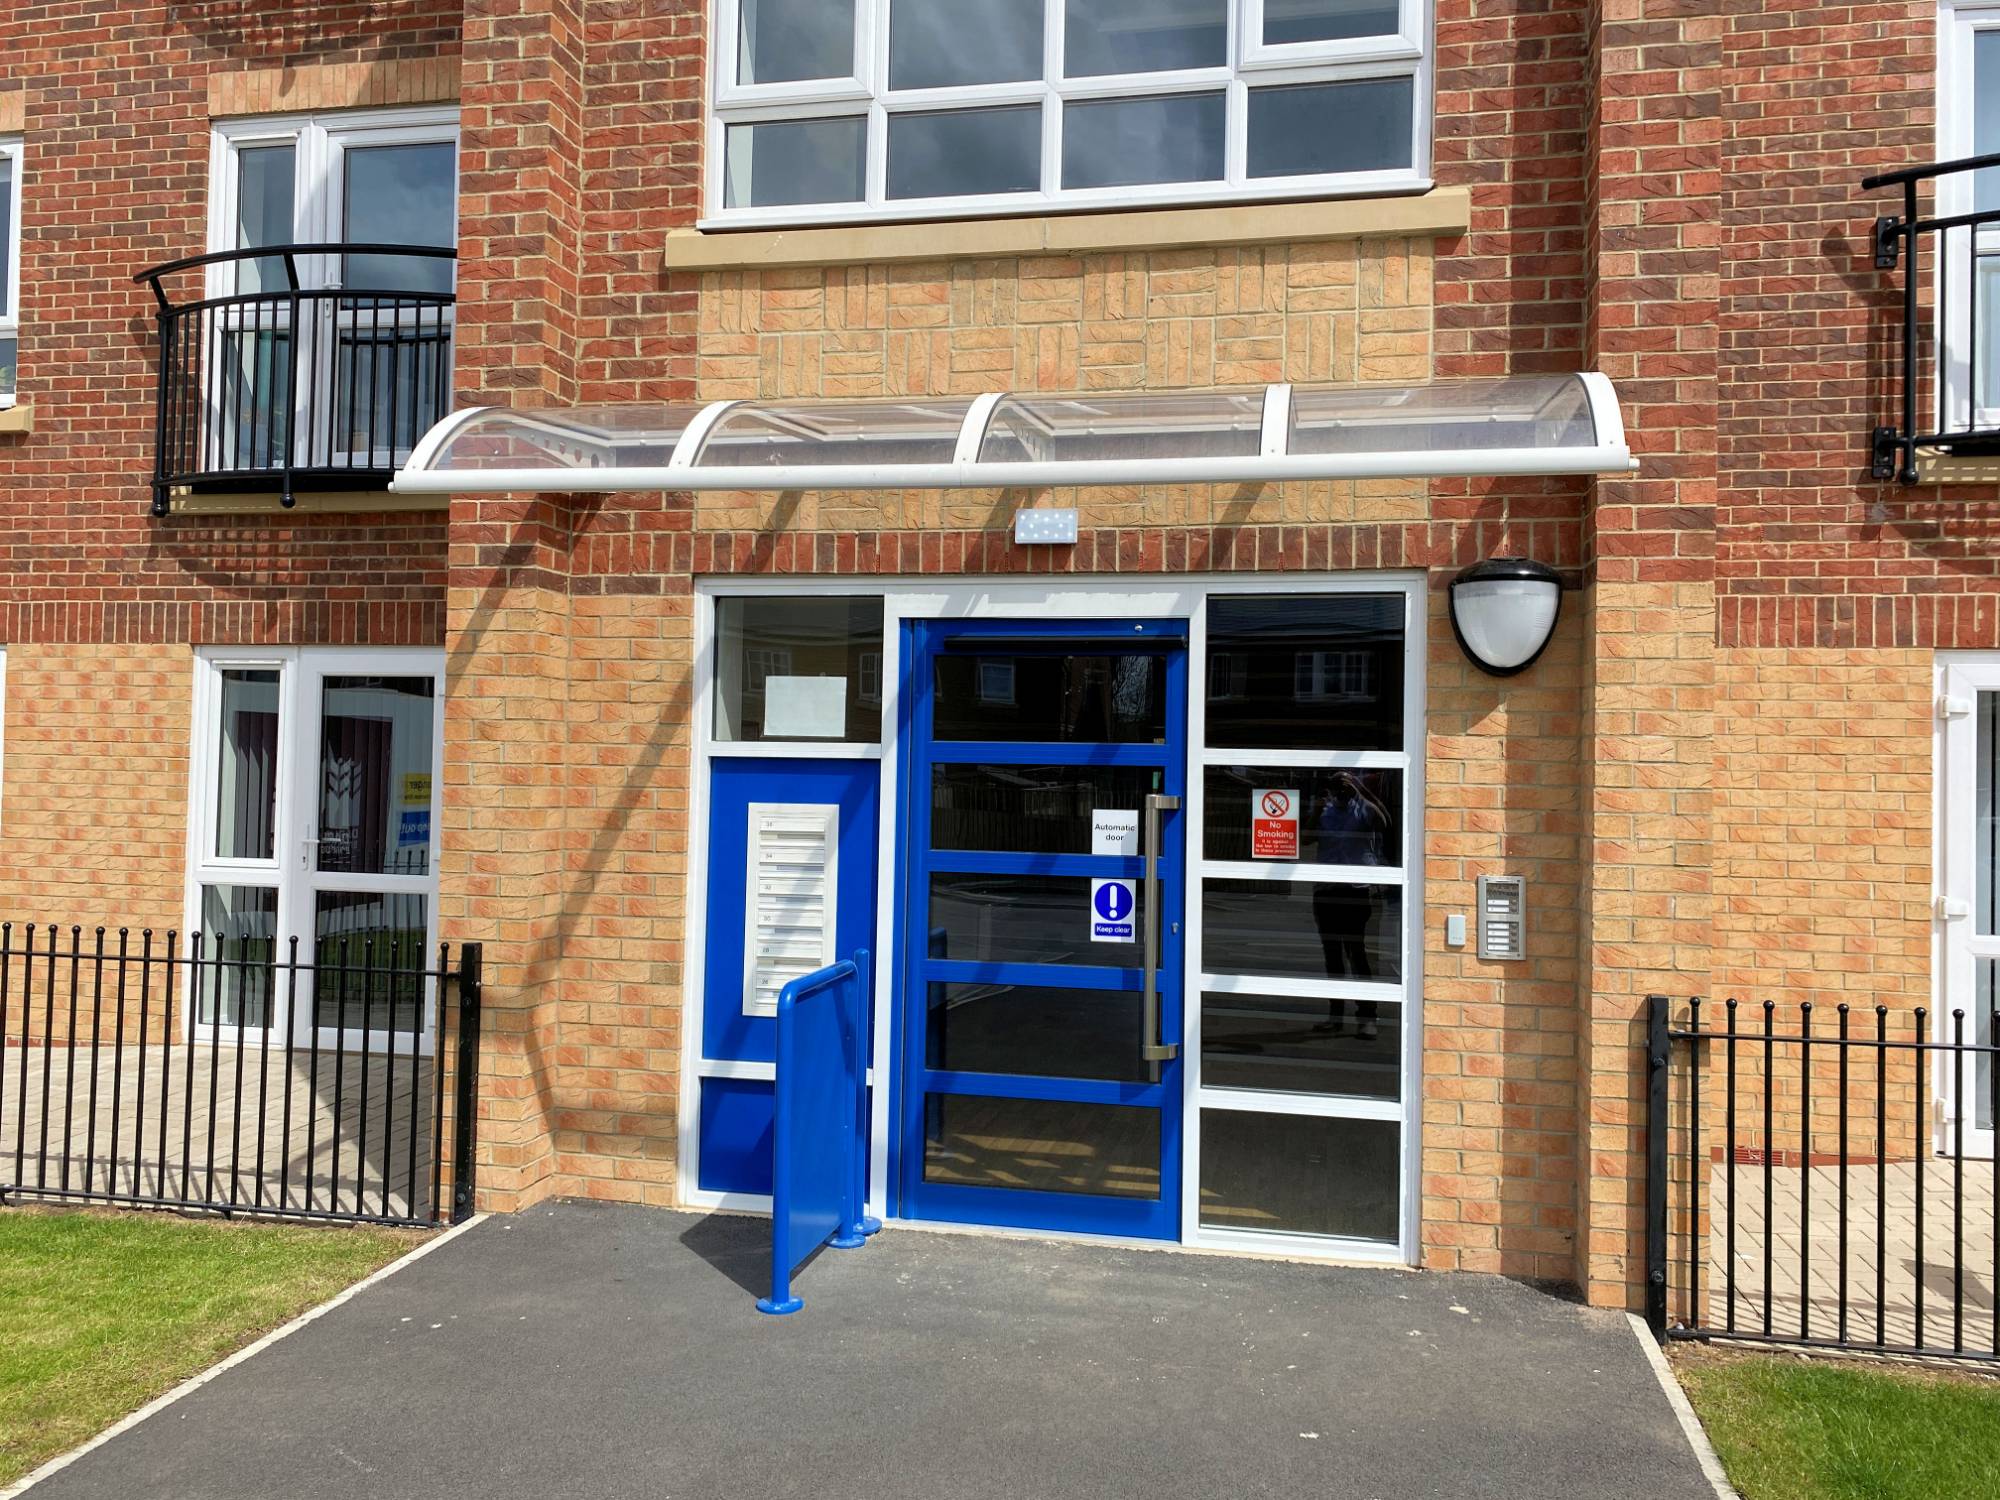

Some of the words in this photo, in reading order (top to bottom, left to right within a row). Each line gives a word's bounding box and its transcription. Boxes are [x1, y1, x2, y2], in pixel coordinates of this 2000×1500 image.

[1094, 824, 1135, 832] Automatic
[1270, 820, 1281, 829] No
[1105, 832, 1124, 841] door
[1257, 830, 1294, 839] Smoking
[1096, 925, 1114, 934] Keep
[1114, 926, 1131, 934] clear
